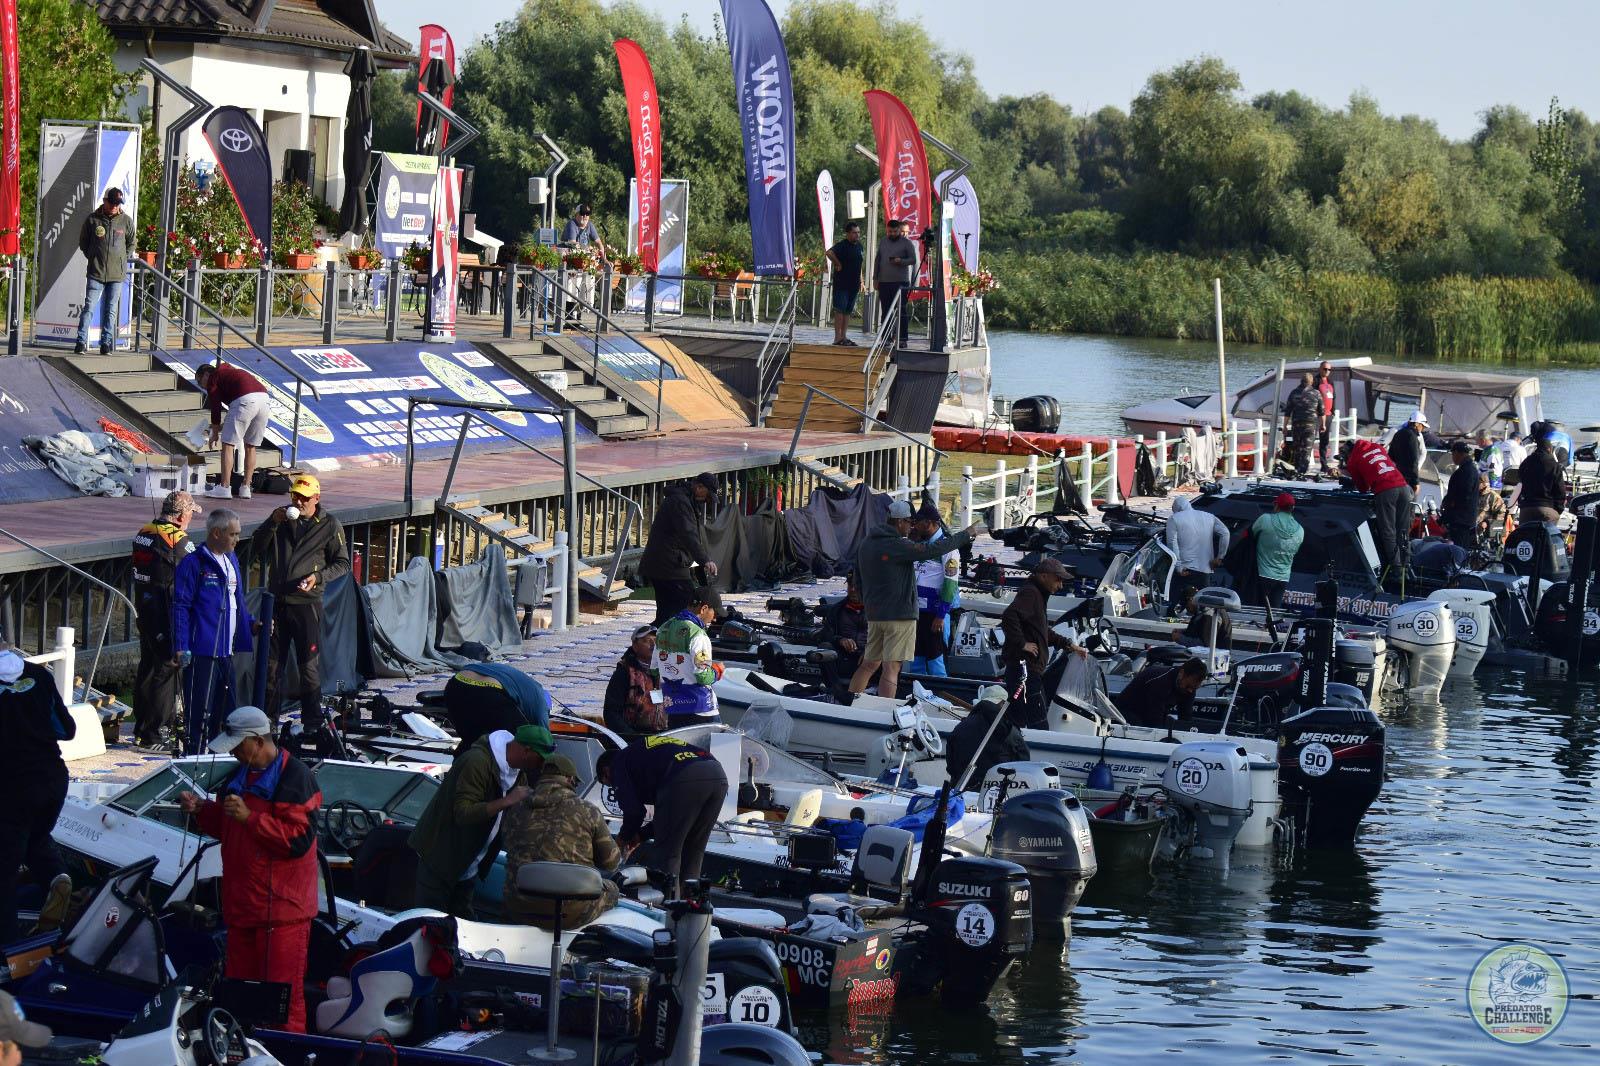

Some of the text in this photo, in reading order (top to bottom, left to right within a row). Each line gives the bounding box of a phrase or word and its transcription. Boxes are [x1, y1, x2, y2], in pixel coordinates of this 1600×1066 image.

[44, 180, 91, 249] DAIWA
[402, 216, 425, 229] NetBet
[659, 213, 680, 236] MIN
[298, 352, 366, 370] NetBet
[1417, 619, 1434, 630] 30
[1457, 624, 1473, 635] 32
[1583, 619, 1598, 629] 34
[960, 633, 977, 646] 35
[1301, 669, 1310, 697] TALON
[1356, 672, 1369, 681] 115
[1200, 706, 1219, 714] 470
[1294, 731, 1370, 745] MERCURY
[1171, 760, 1226, 771] HDA
[1305, 752, 1327, 768] 90
[1181, 769, 1202, 785] 20
[1028, 836, 1063, 848] YAMAHA
[938, 882, 991, 898] SUZUKI
[962, 916, 987, 935] 14
[797, 964, 829, 988] MC
[740, 1003, 770, 1023] 10
[655, 1000, 669, 1048] TALON
